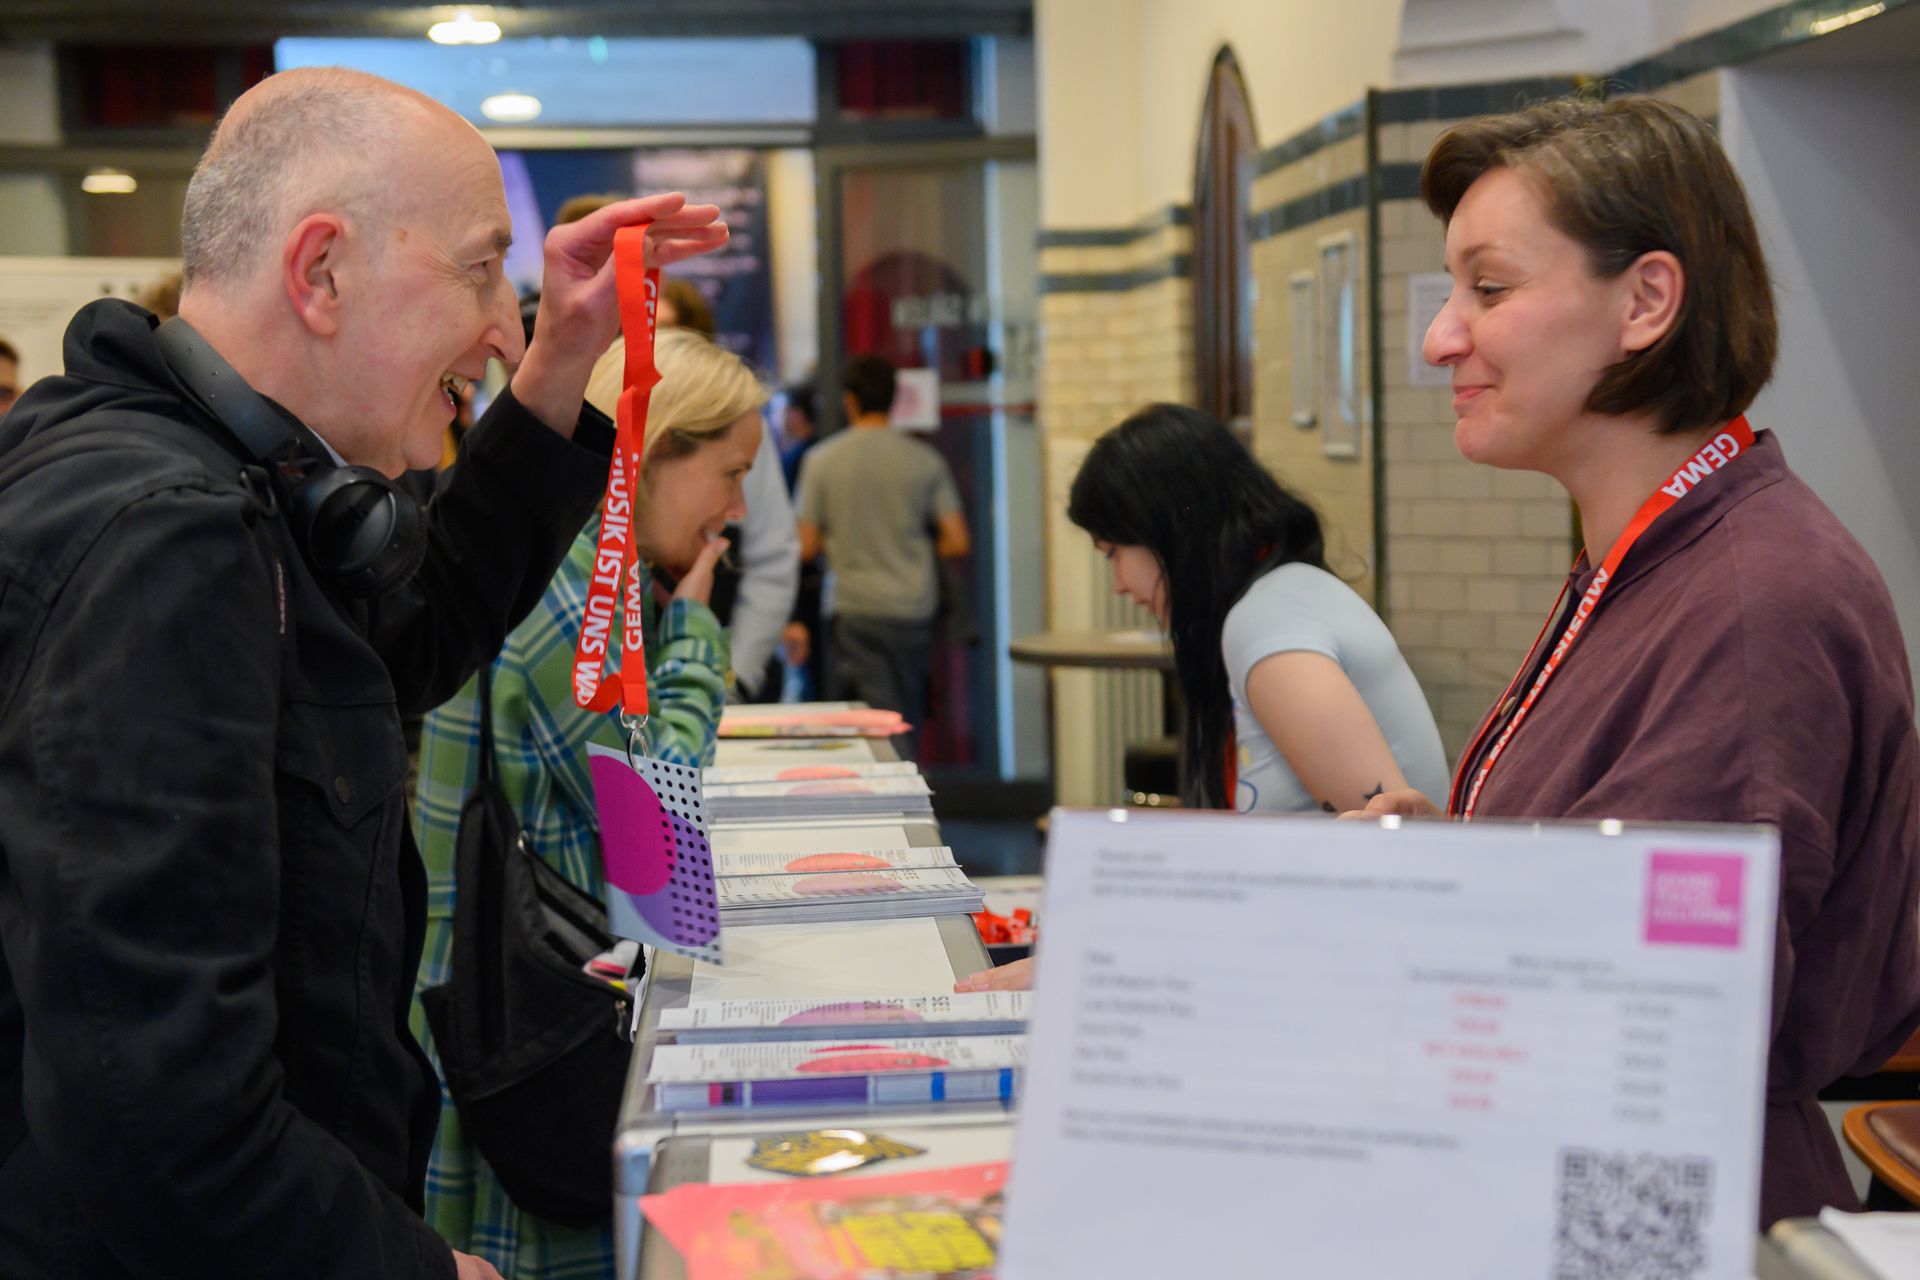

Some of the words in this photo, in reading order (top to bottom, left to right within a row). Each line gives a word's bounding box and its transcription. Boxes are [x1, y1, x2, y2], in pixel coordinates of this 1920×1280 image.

[1661, 433, 1740, 499] GEMA
[594, 548, 624, 592] IST
[581, 594, 615, 656] UNS
[625, 559, 643, 652] GEMA
[1552, 567, 1609, 661] MUSIK
